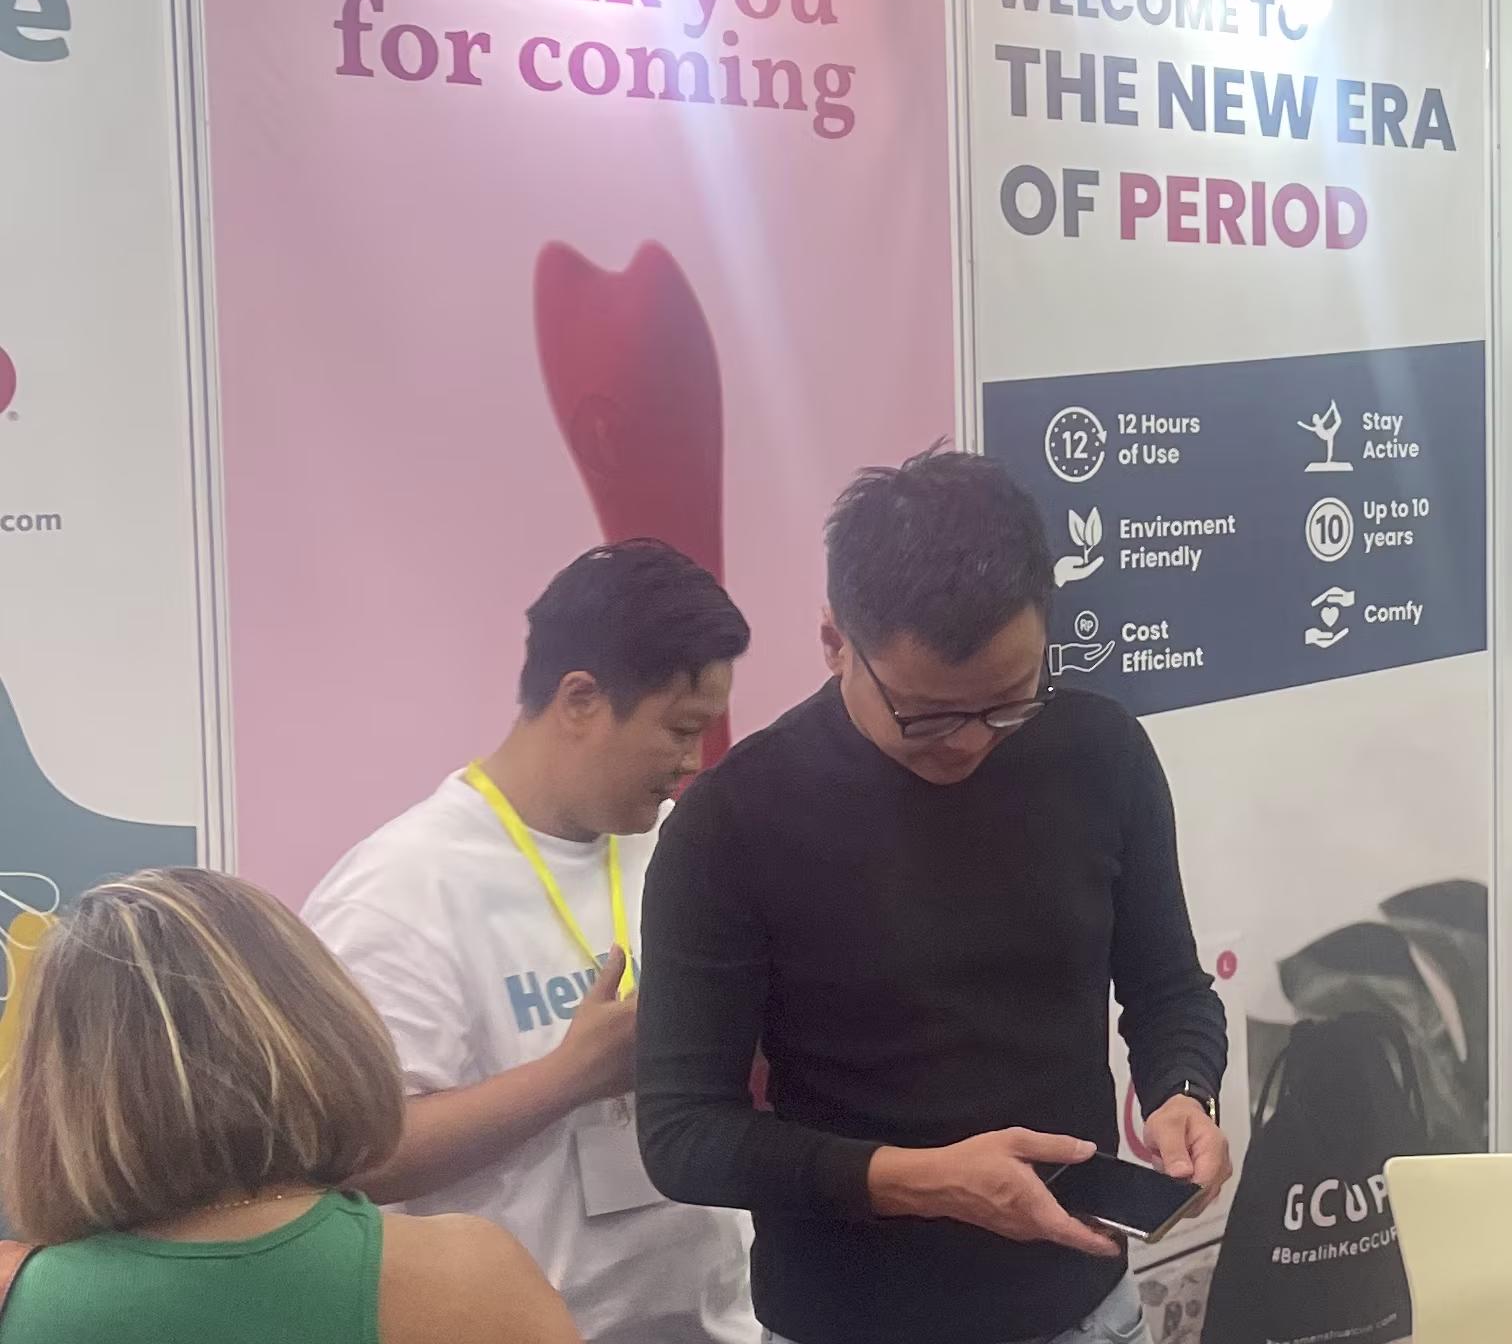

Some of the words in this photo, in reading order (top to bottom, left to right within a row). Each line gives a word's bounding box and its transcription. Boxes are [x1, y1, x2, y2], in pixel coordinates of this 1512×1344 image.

[519, 30, 856, 139] coming
[995, 44, 1139, 126] THE
[1158, 61, 1318, 140] NEW
[1336, 78, 1456, 151] ERA
[1000, 164, 1100, 238] OF
[1120, 171, 1368, 250] PERIOD
[1118, 413, 1137, 434] 12
[1141, 413, 1200, 434] Hours
[1362, 412, 1403, 436] Stay
[1062, 430, 1089, 459] 12
[1118, 443, 1139, 465] of
[1143, 444, 1180, 464] Use
[1363, 438, 1420, 459] Active
[1363, 501, 1387, 525] Up
[1391, 499, 1409, 518] to
[1412, 498, 1430, 517] 10
[1119, 515, 1236, 539] Enviroment
[1316, 513, 1344, 545] 10
[1363, 530, 1414, 554] years
[1120, 546, 1203, 572] Friendly
[1363, 600, 1424, 625] Comfy
[1121, 620, 1169, 643] Cost
[1122, 647, 1204, 673] Efficient
[1283, 1173, 1389, 1231] GCUP
